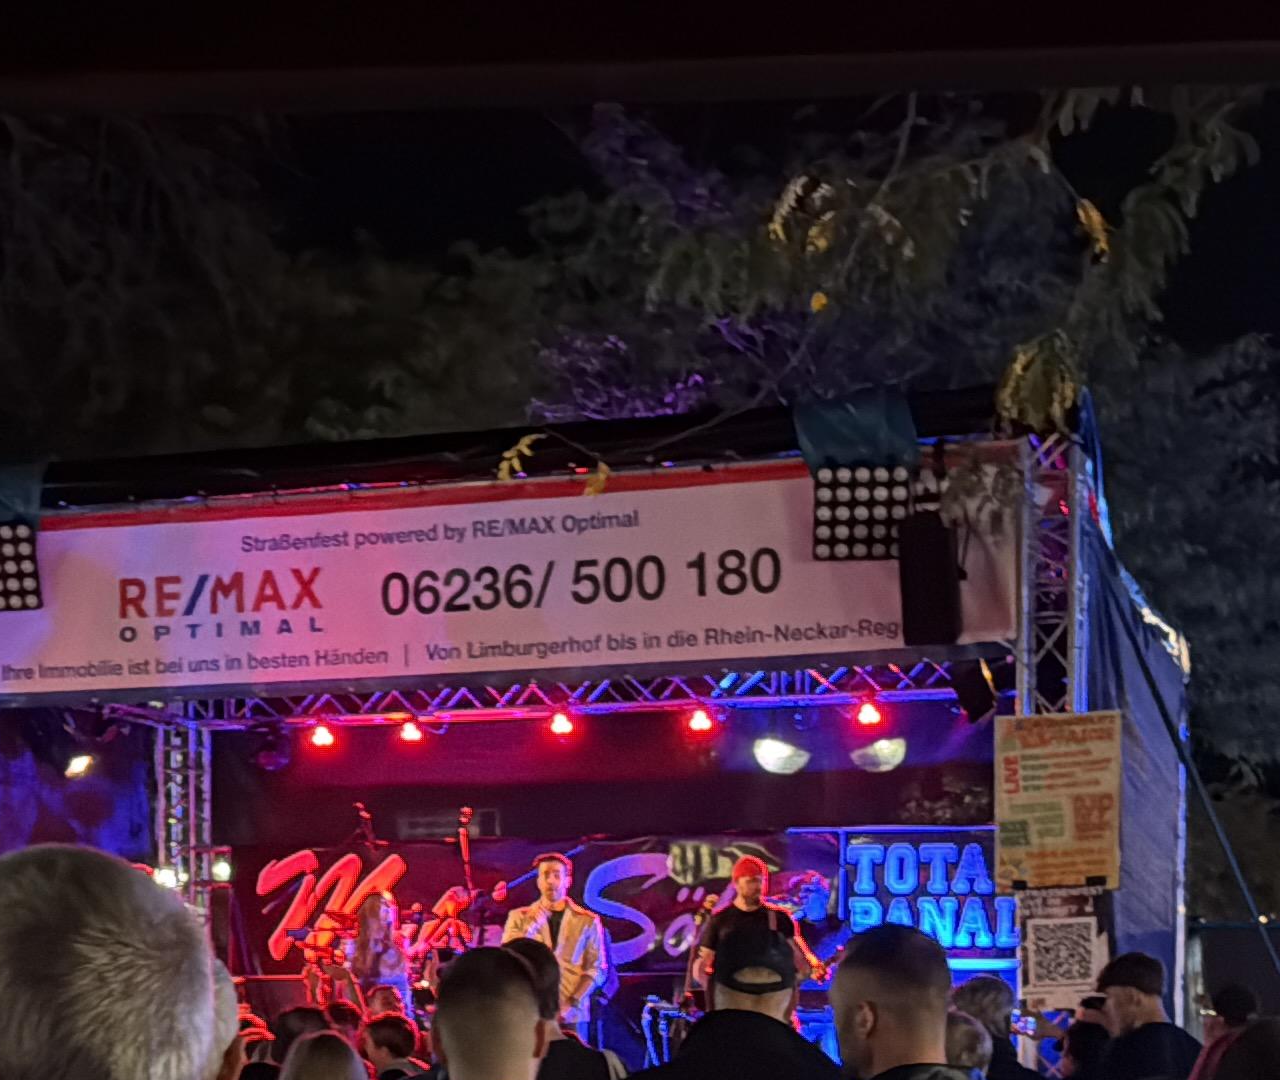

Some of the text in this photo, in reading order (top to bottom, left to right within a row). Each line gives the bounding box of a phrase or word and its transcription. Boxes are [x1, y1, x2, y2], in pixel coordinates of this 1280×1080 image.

[241, 510, 639, 552] Straßenfest powered by RE/MAX Optimal
[119, 567, 323, 619] RE/MAX
[381, 548, 781, 615] 06236/ 500 180
[1, 618, 901, 681] Ihre Immobilie ist bei uns in besten Händen Von Limburgerhof bis in die Rhein-Neckar-Reg
[119, 616, 324, 642] OPTIMAL
[846, 842, 994, 894] TOTA
